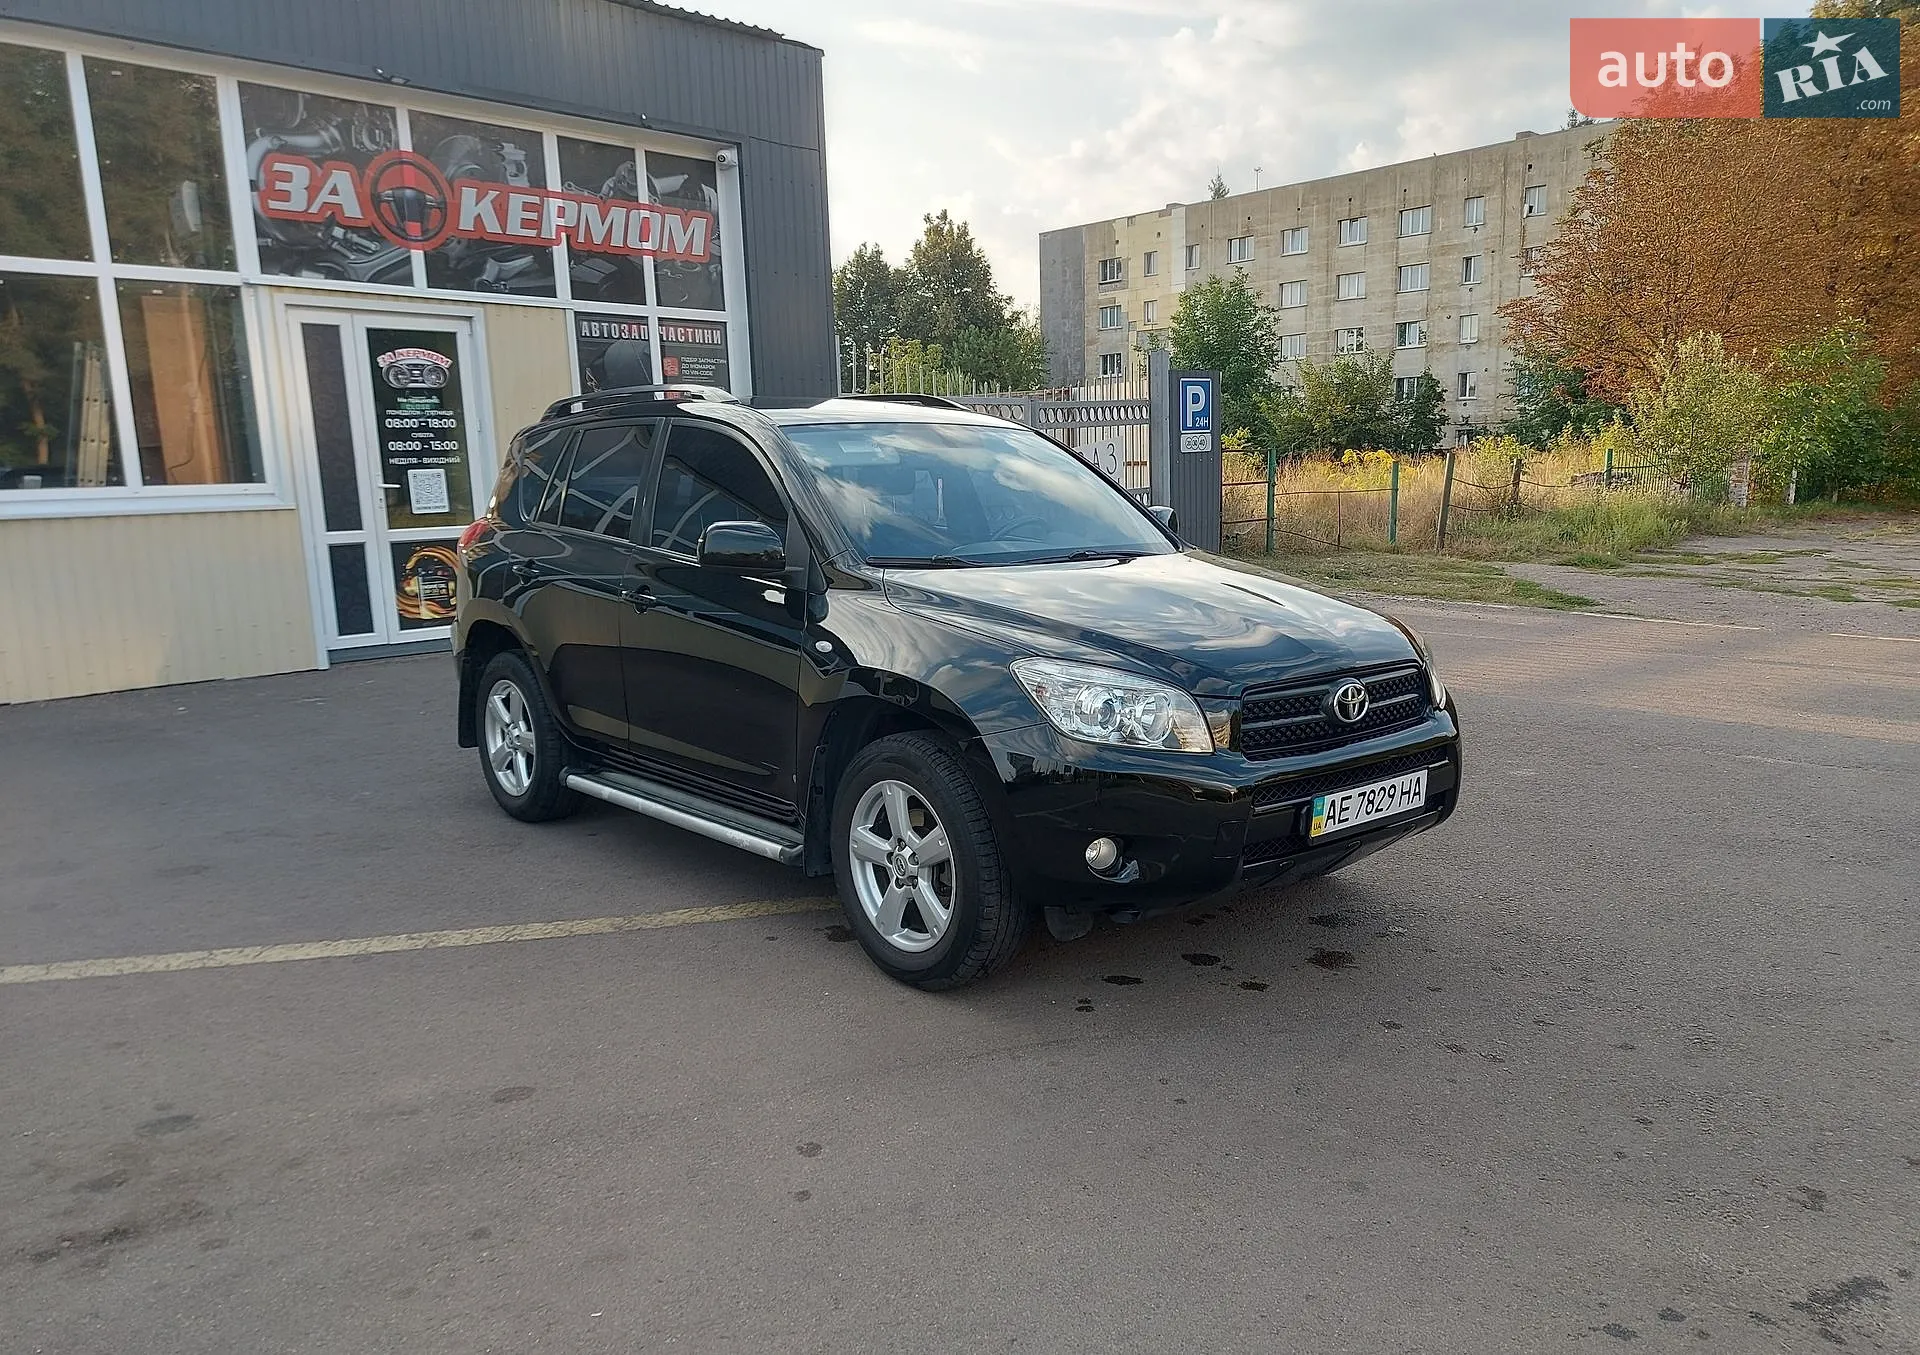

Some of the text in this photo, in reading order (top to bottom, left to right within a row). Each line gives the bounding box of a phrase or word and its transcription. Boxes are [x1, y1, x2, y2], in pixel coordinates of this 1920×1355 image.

[268, 162, 707, 257] ЗА КЕРМОМ
[1187, 386, 1206, 427] P
[385, 418, 419, 428] 08:00
[427, 418, 457, 428] 18:00
[1195, 416, 1209, 427] 24H
[388, 441, 422, 450] 08:00
[430, 441, 458, 450] 15:00
[1324, 776, 1421, 828] AE 7829 HA
